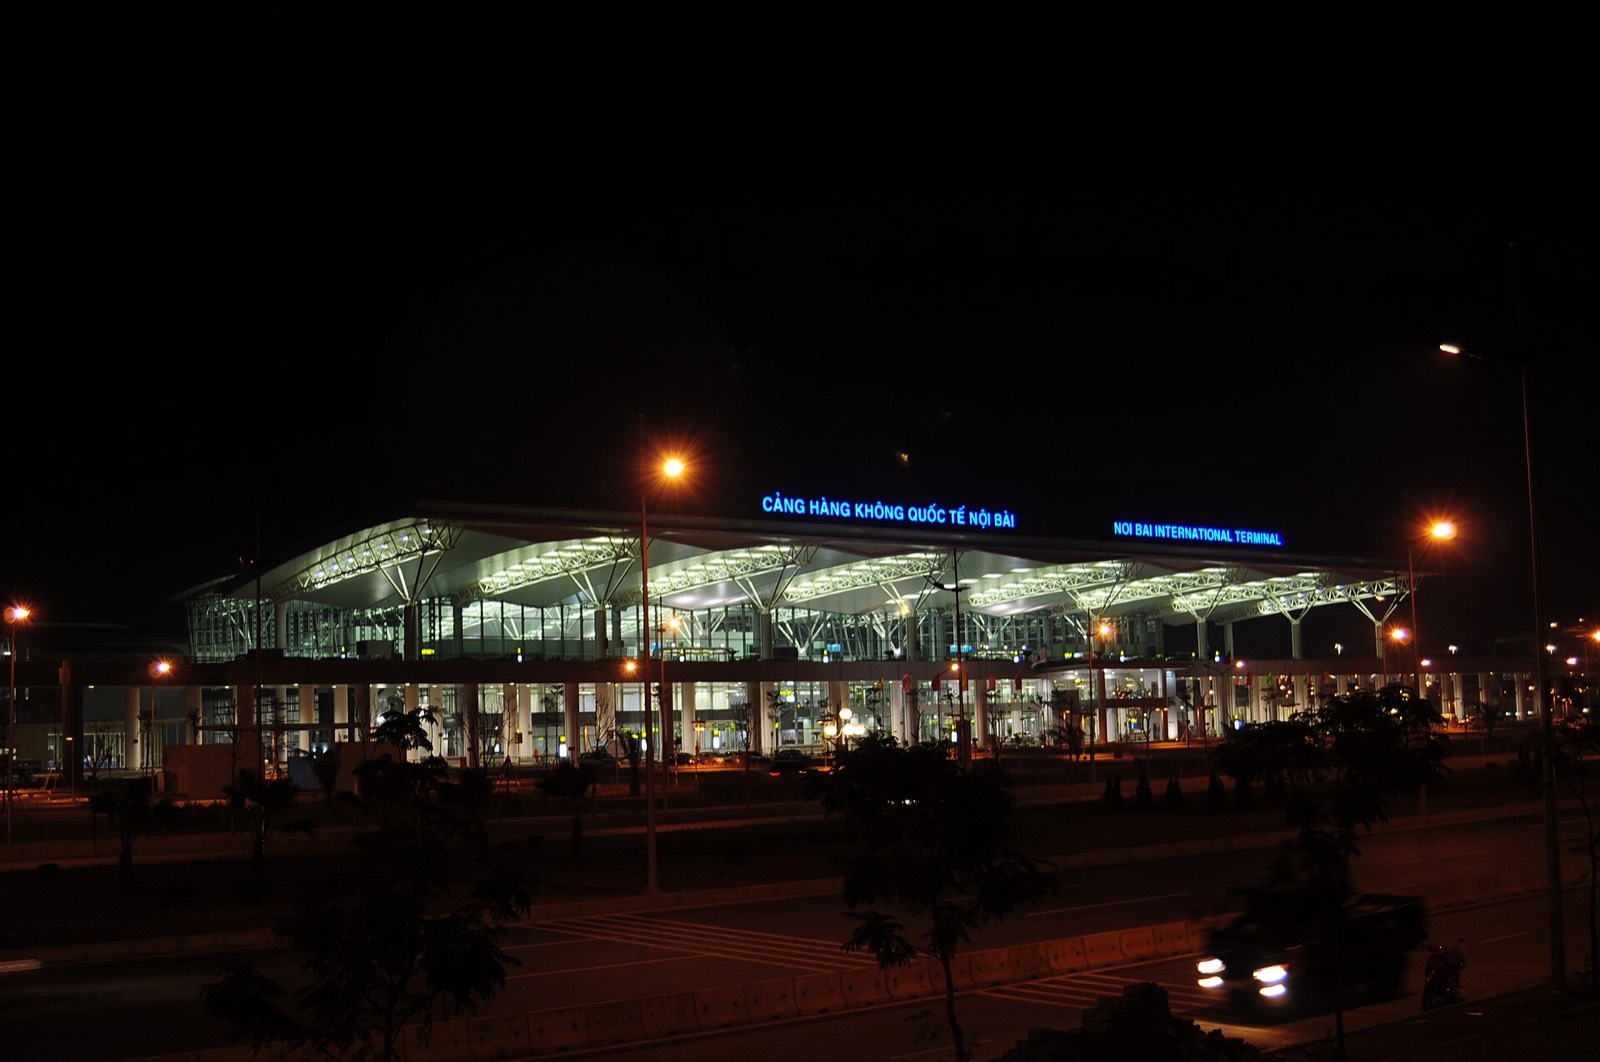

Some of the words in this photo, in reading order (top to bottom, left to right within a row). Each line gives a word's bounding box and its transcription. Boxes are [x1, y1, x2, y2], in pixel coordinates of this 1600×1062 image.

[762, 492, 805, 515] CẢNG
[810, 497, 851, 518] HÀNG
[855, 501, 904, 521] KHÔNG
[908, 503, 946, 524] QUỐC
[949, 505, 966, 525] TẾ
[969, 508, 991, 529] NỘI
[994, 510, 1015, 528] BÀI
[1113, 521, 1133, 536] NOI
[1135, 523, 1153, 537] BAI
[1155, 525, 1233, 542] INTERNATIONAL
[1235, 530, 1282, 546] TERMINAL
